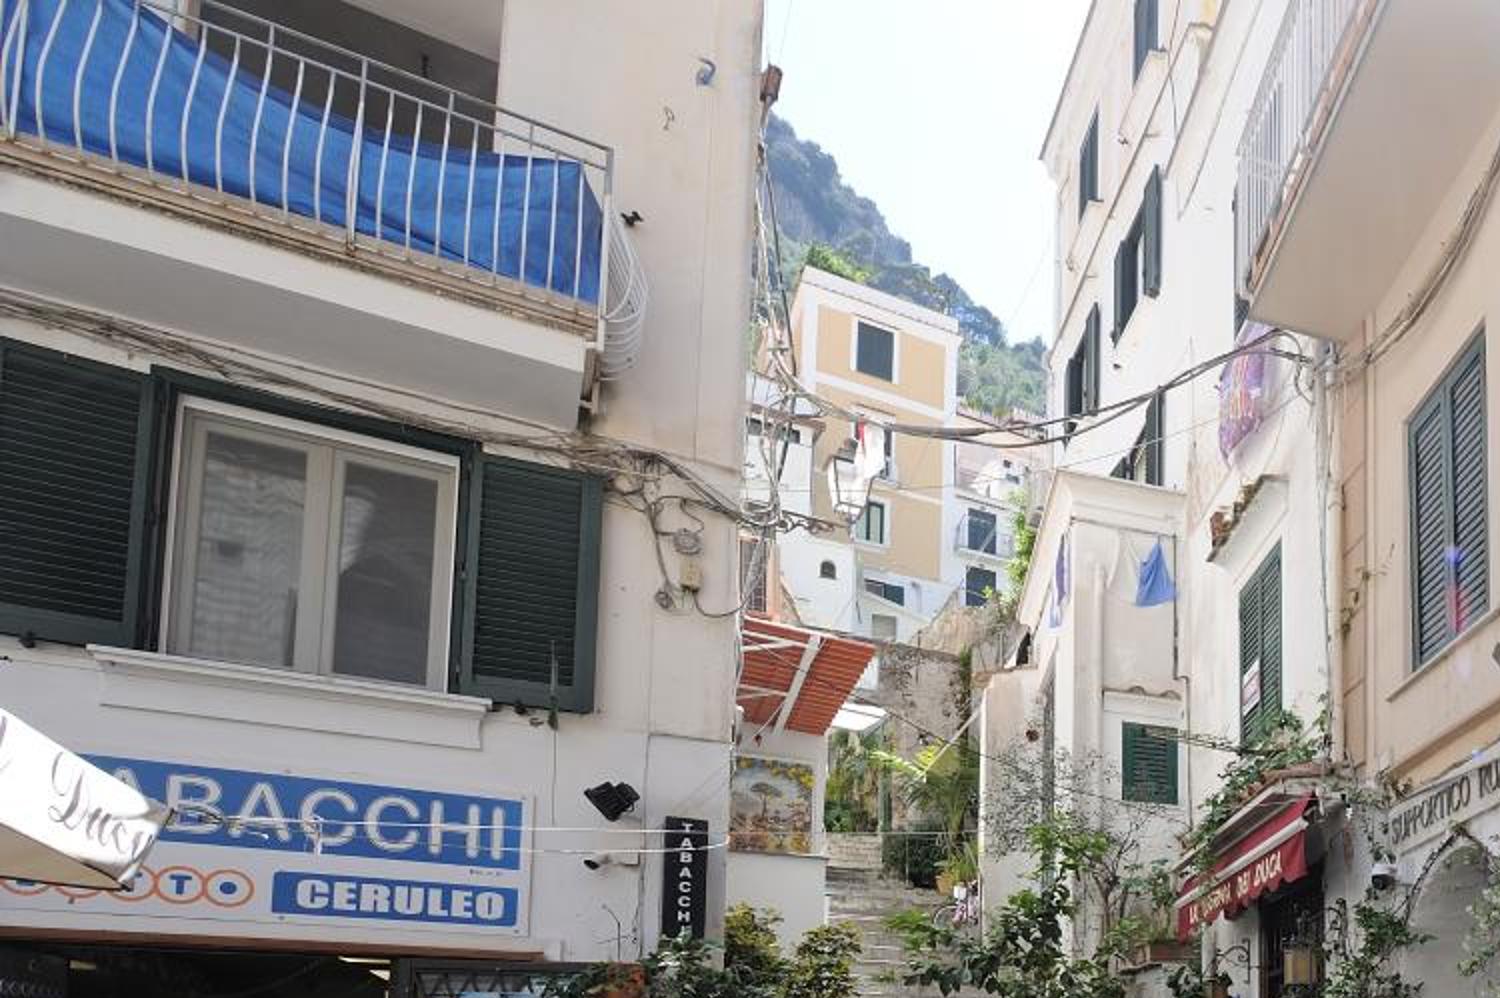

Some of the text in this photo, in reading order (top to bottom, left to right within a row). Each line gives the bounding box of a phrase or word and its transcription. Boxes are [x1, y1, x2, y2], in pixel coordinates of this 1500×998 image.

[112, 767, 505, 860] BACCHI
[1391, 774, 1471, 845] SUPPORTICO
[297, 879, 505, 920] CERULEO
